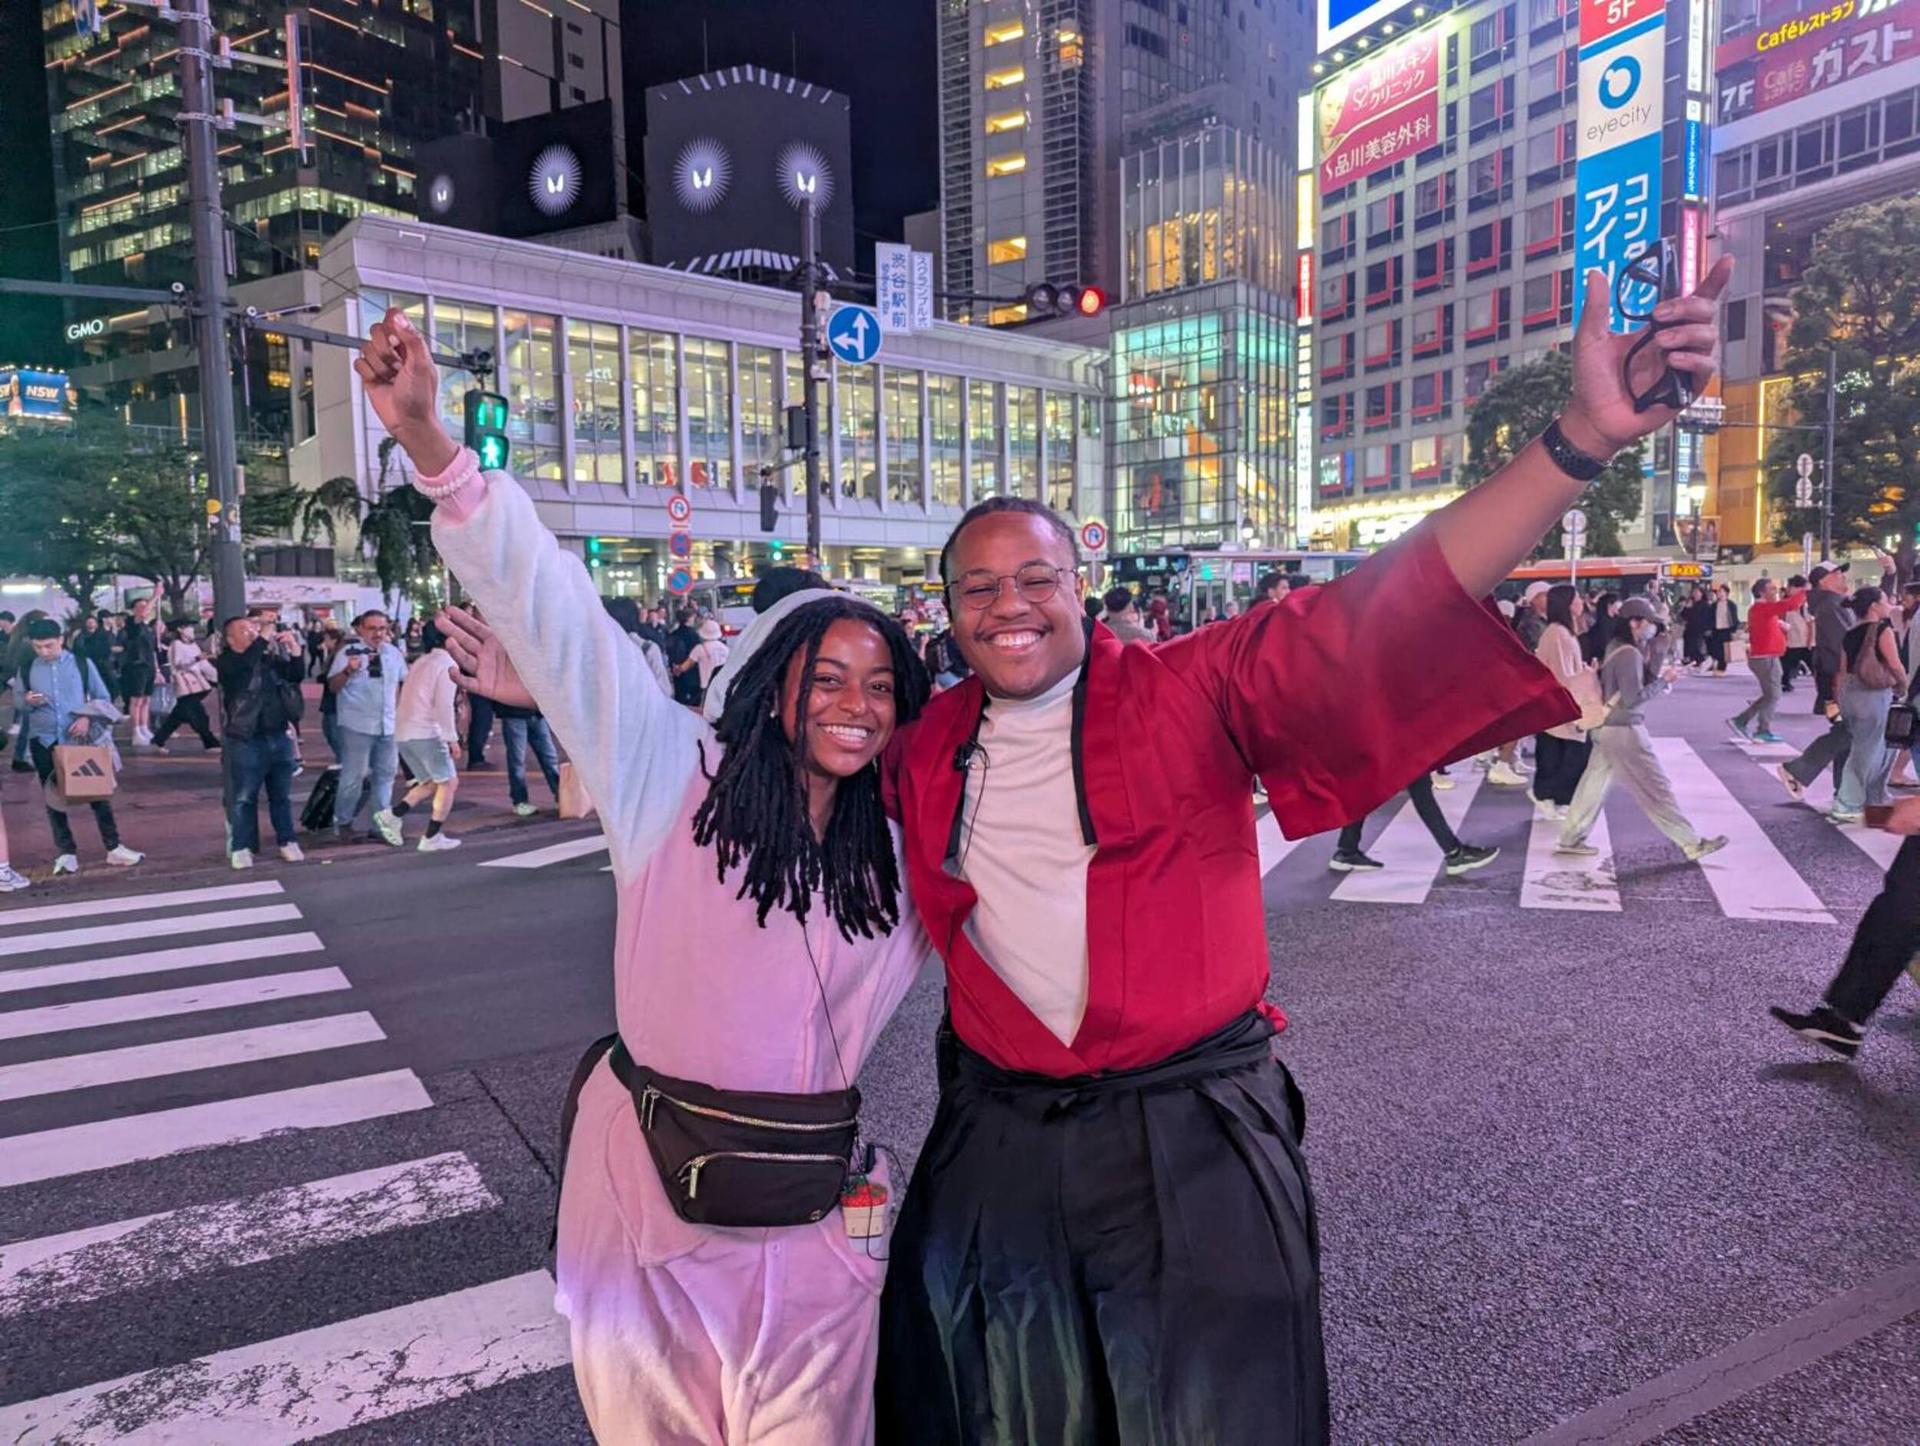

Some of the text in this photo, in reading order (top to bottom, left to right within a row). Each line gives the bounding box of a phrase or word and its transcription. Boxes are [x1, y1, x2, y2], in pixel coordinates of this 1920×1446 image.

[1606, 0, 1636, 25] 5F
[1810, 22, 1914, 90] ガスト
[1370, 70, 1425, 109] クリニック
[1721, 79, 1755, 113] 7F
[1586, 103, 1652, 143] eyecity
[1335, 113, 1432, 178] 品川美容外科
[891, 252, 907, 328] 渋谷駅前
[67, 319, 104, 340] GMO
[25, 385, 59, 399] NSW
